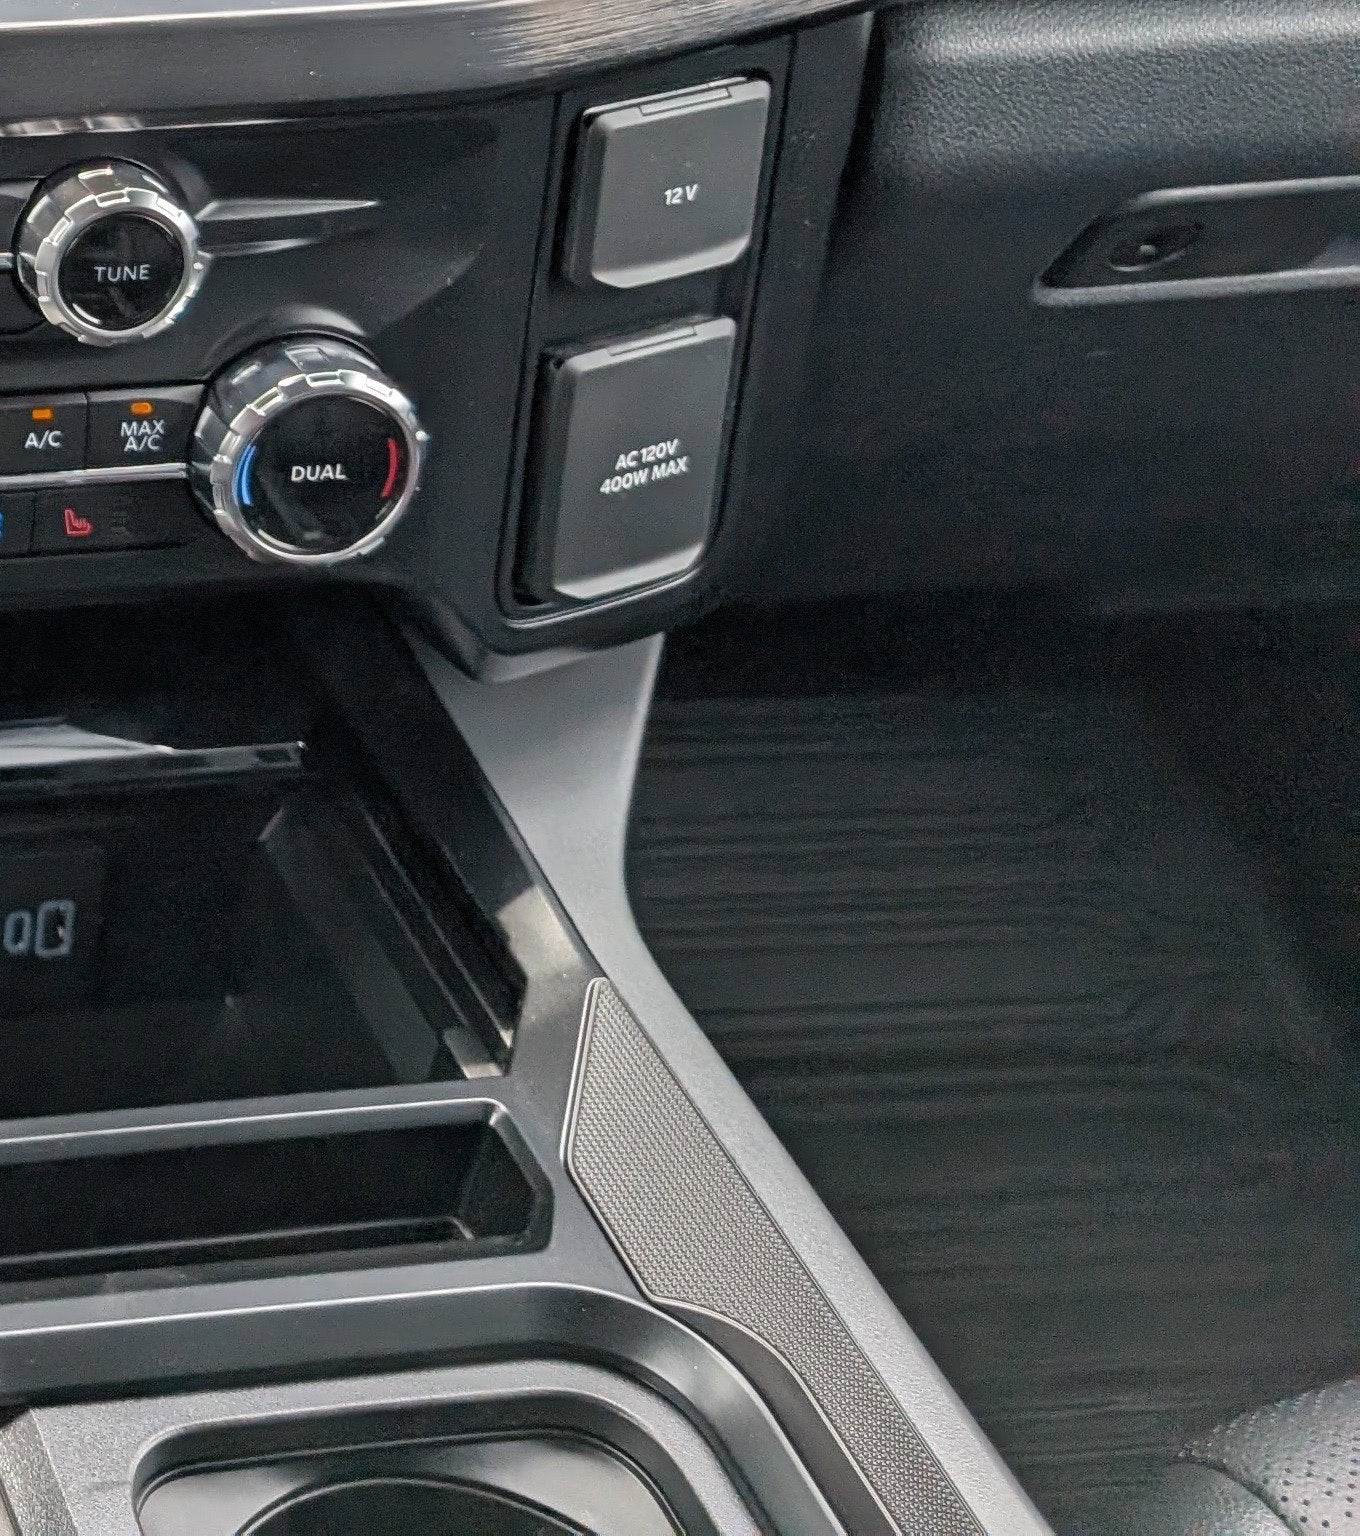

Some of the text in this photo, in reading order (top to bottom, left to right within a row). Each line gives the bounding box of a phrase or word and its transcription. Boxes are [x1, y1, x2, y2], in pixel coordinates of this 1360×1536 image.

[95, 264, 150, 282] TUNE
[121, 420, 163, 438] MAX
[25, 431, 60, 448] A/C
[124, 434, 159, 451] A/C
[615, 438, 681, 471] AC 120V
[291, 464, 346, 481] DUAL
[599, 457, 688, 494] 400W MAX
